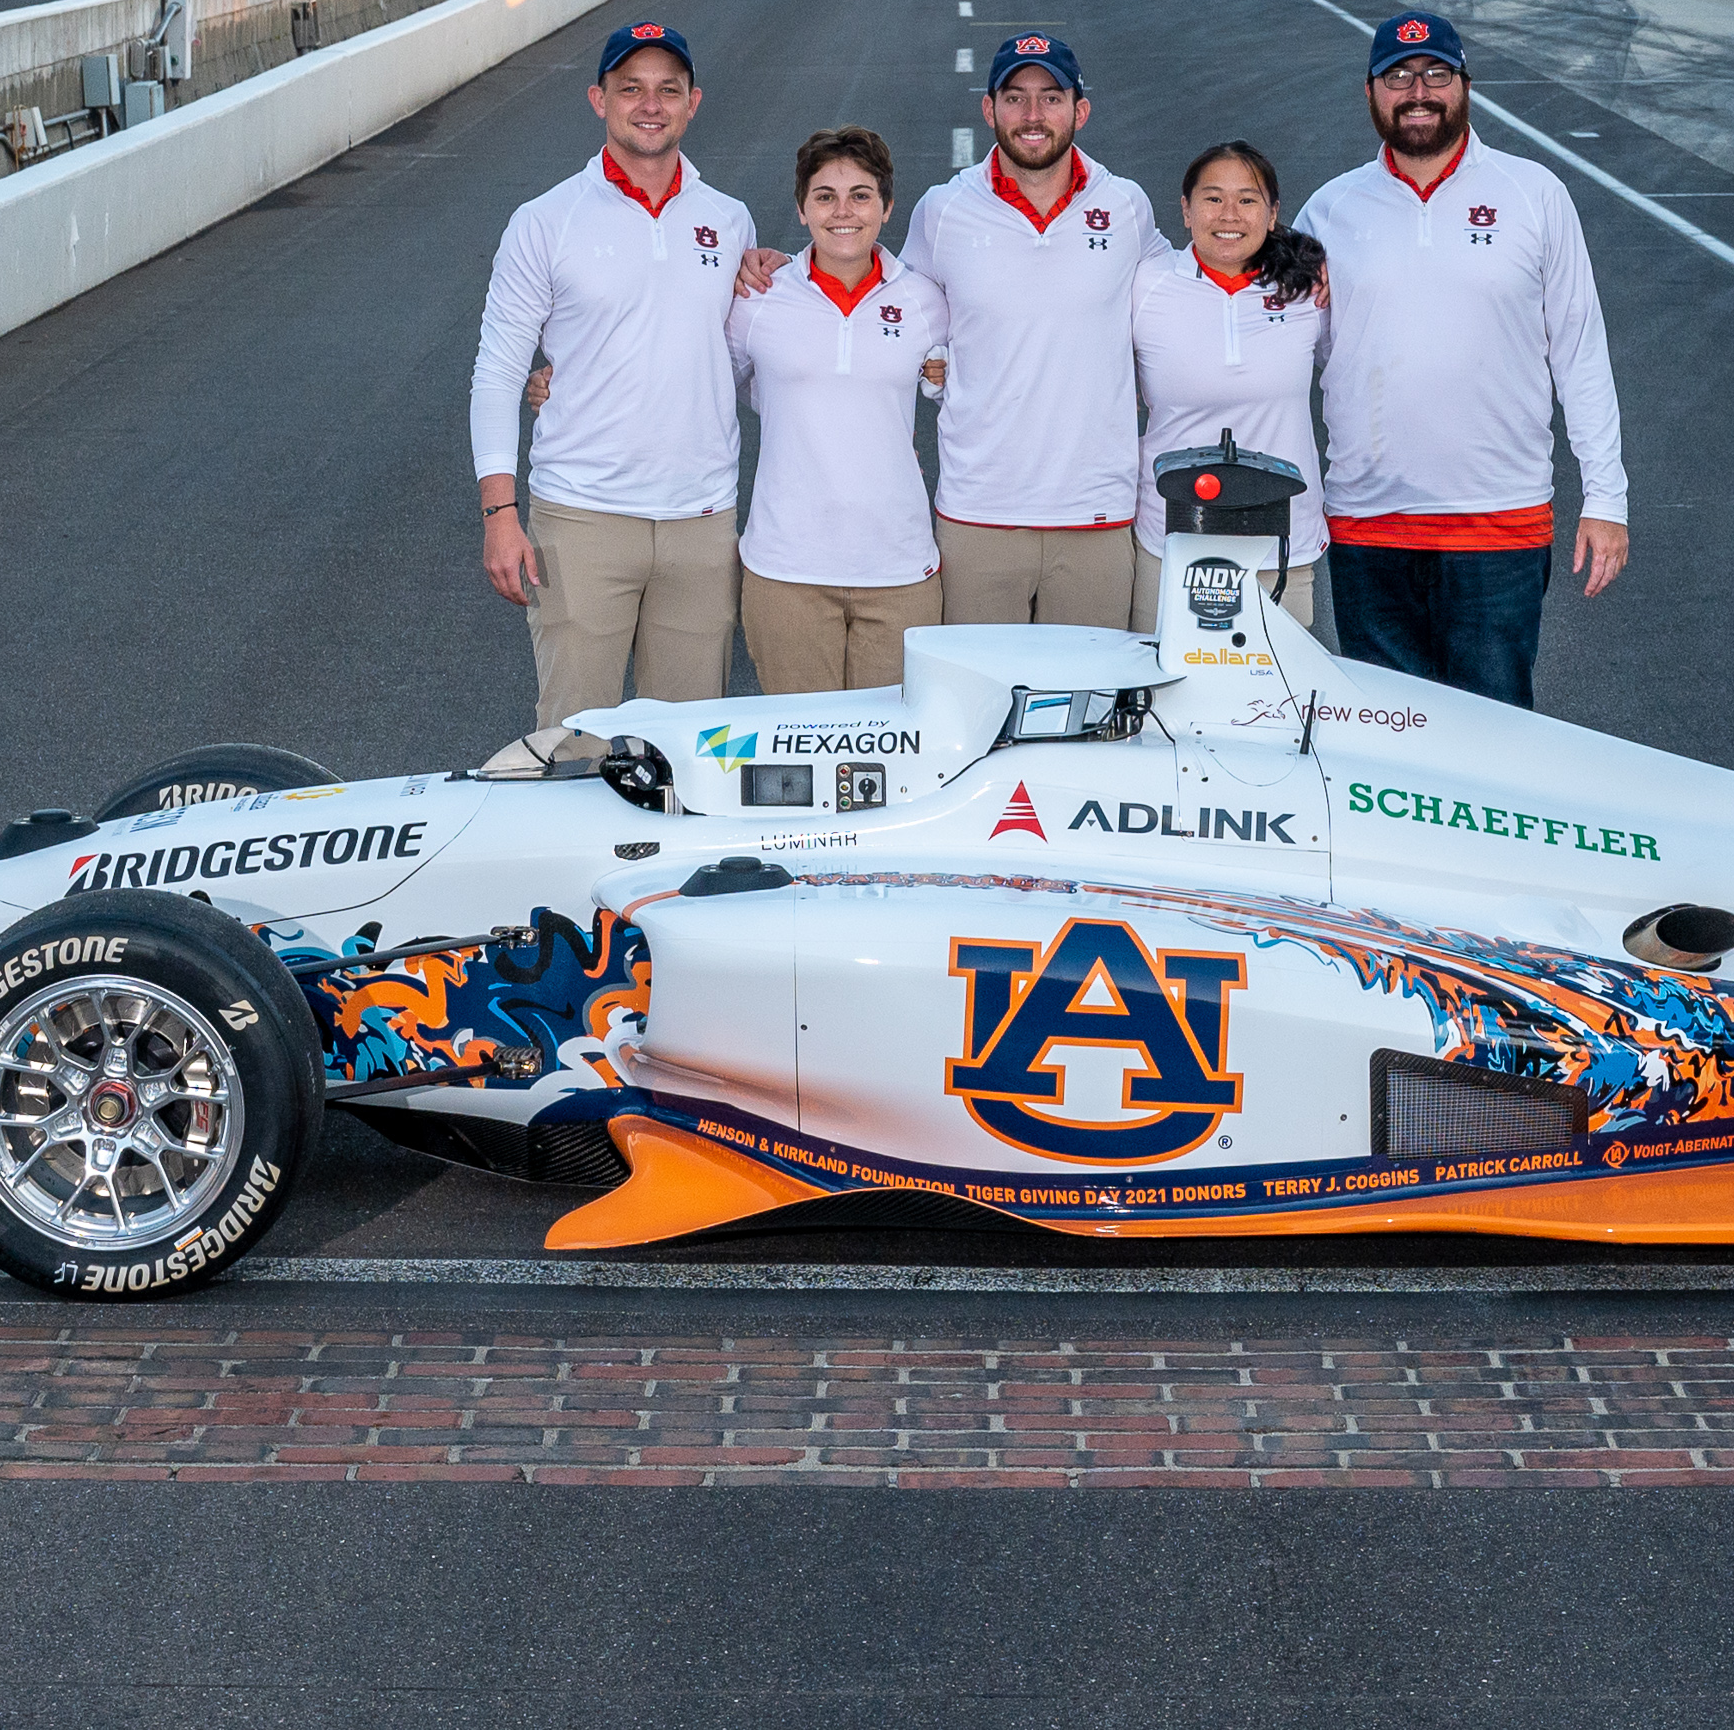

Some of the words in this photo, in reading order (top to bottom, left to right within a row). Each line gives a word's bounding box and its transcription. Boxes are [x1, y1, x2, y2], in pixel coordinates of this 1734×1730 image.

[1185, 567, 1246, 589] INDY
[1191, 587, 1240, 596] AUTONOMOUS
[1194, 594, 1237, 603] CHALLENGE
[1184, 648, 1273, 665] dallara
[776, 720, 862, 730] powered
[868, 719, 890, 728] by
[1301, 702, 1352, 722] new
[1358, 704, 1428, 732] eagle
[772, 731, 920, 754] HEXAGON
[1069, 801, 1296, 844] ADLINK
[1348, 781, 1661, 862] SCHAEFFLER
[761, 832, 857, 852] LUMINAR
[64, 821, 428, 898] BRIDGESTONE
[697, 1118, 755, 1148] HENSON
[759, 1137, 769, 1152] &
[773, 1141, 848, 1175] KIRKLAND
[851, 1163, 955, 1194] FOUNDATION
[1435, 1159, 1506, 1181] PATRICK
[1510, 1151, 1583, 1172] CARROLL
[965, 1184, 1016, 1203] TIGER
[1020, 1188, 1080, 1204] GIVING
[1085, 1190, 1120, 1205] DAY
[1126, 1188, 1166, 1204] 2021
[1172, 1183, 1246, 1203] DONORS
[1263, 1178, 1322, 1196] TERRY
[1325, 1177, 1340, 1192] J.
[1345, 1169, 1419, 1190] COGGINS
[81, 1154, 281, 1293] BRIDGESTONE
